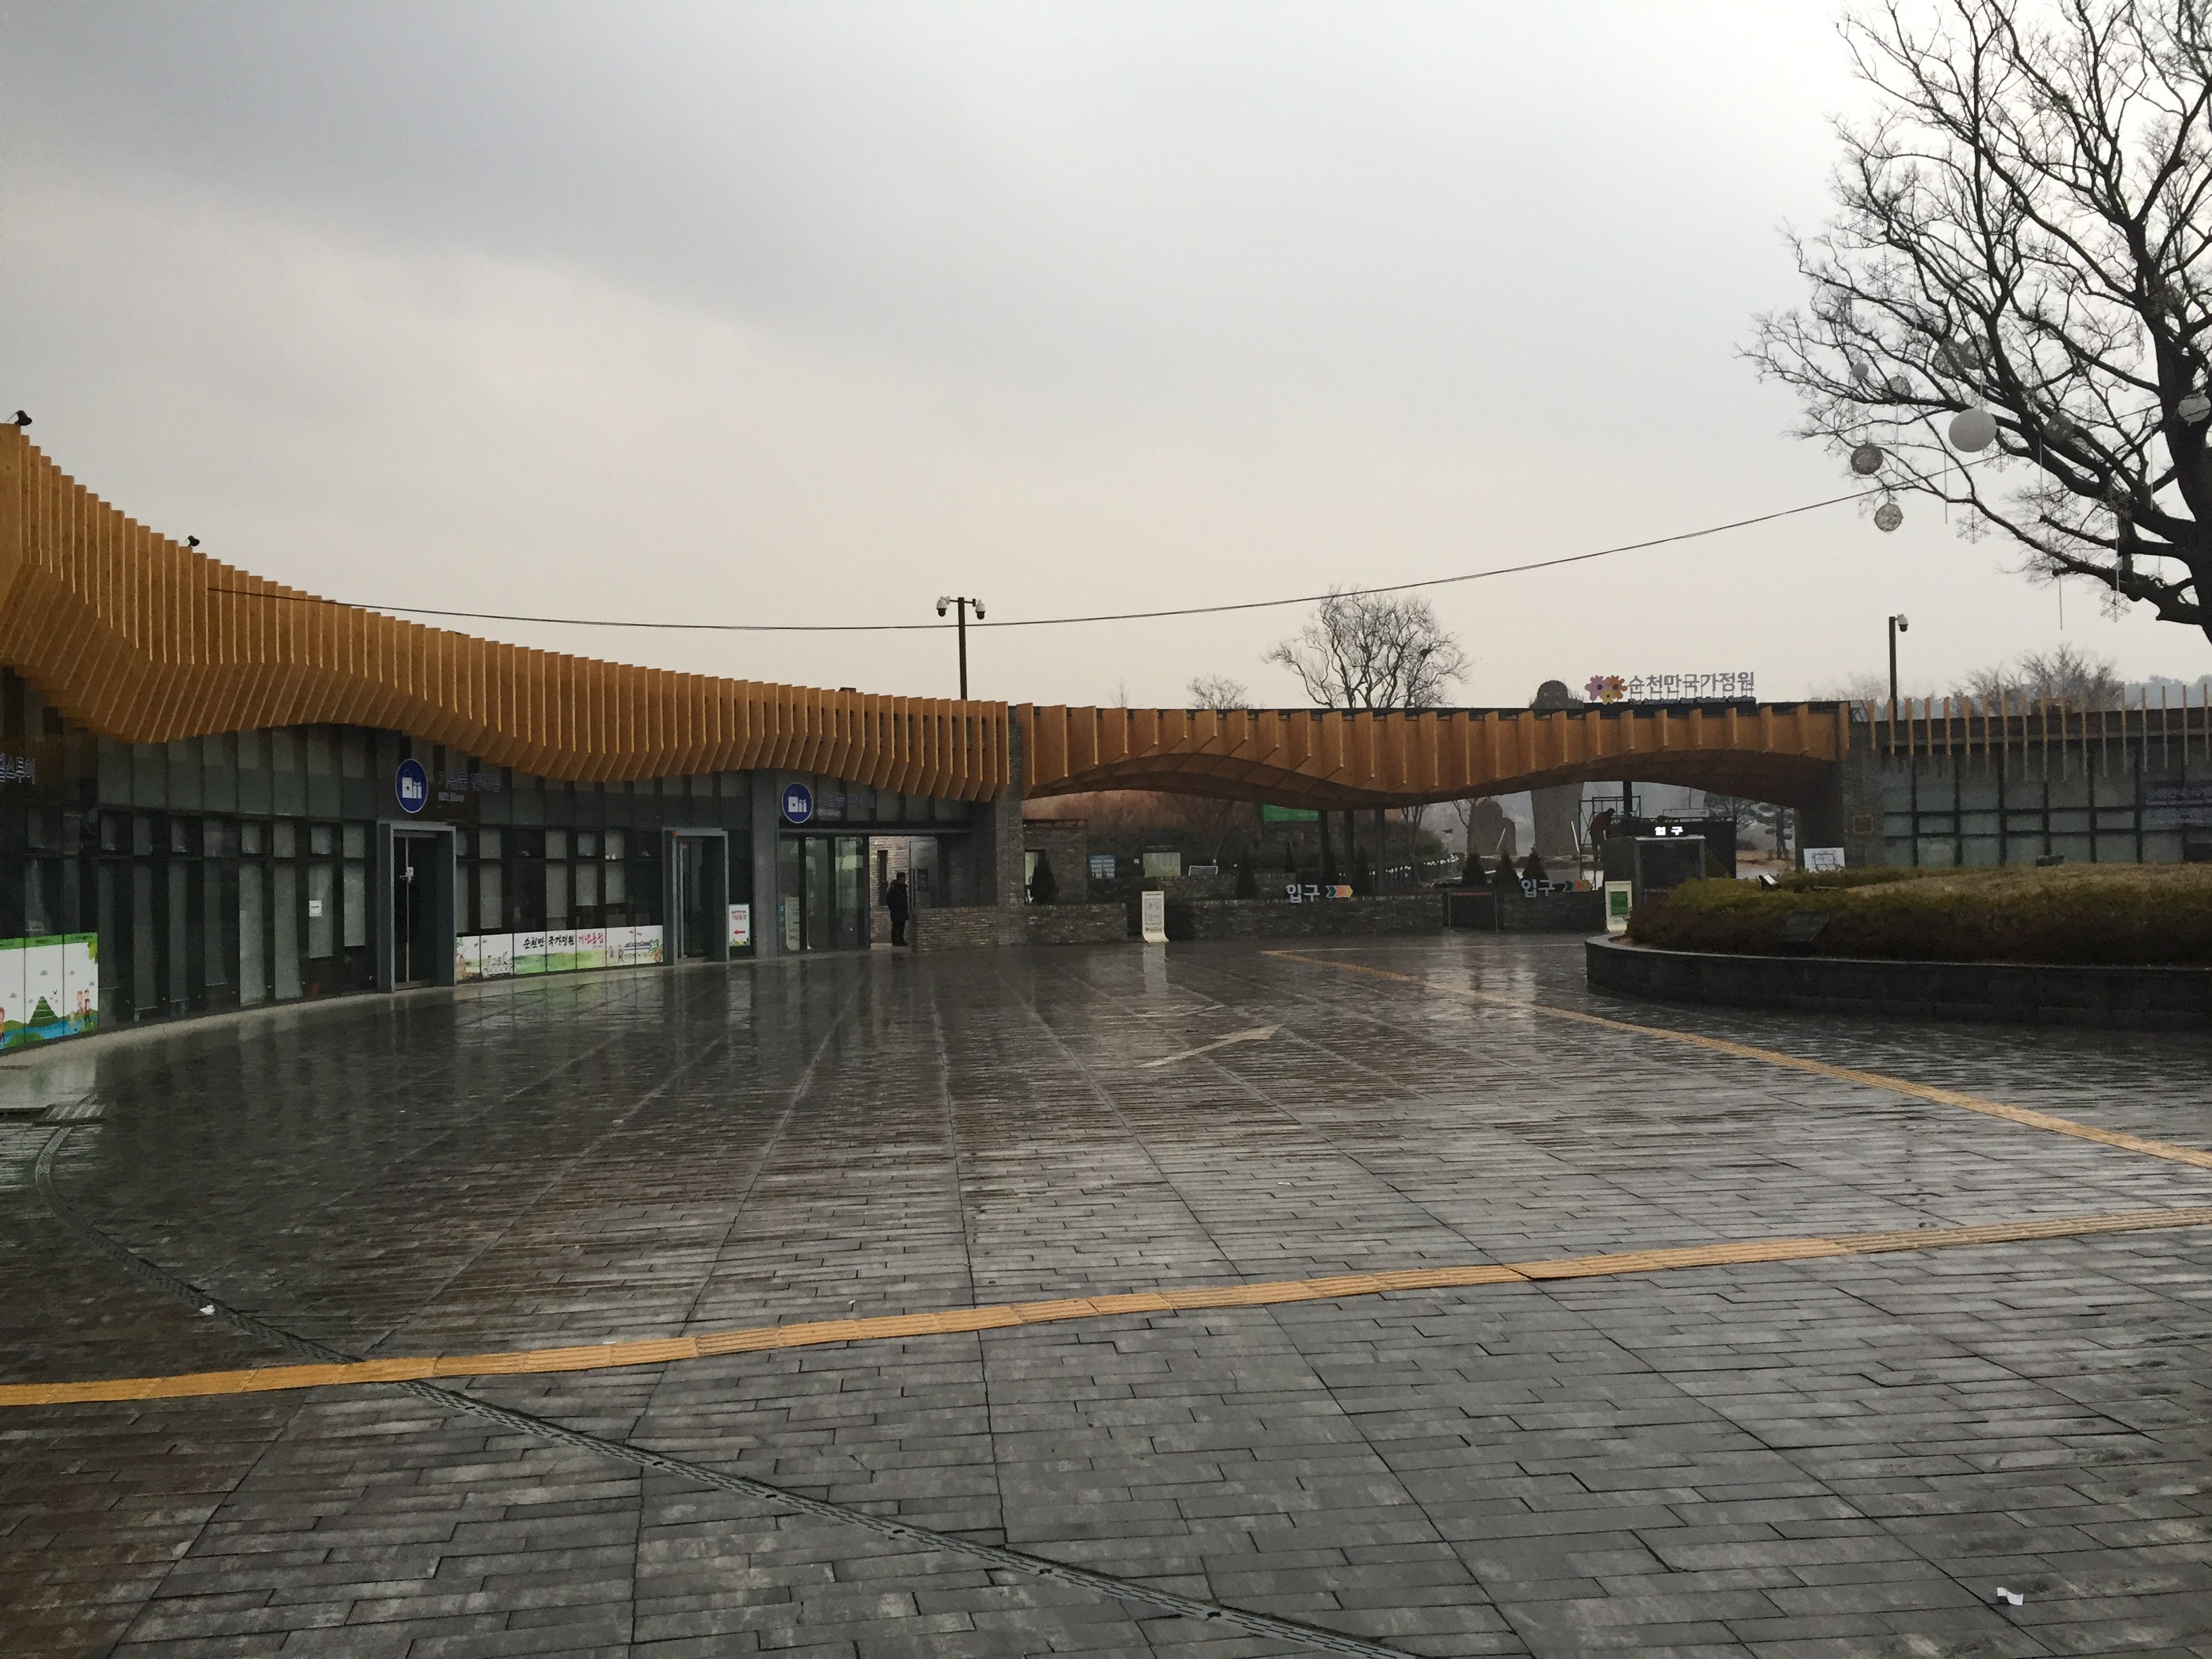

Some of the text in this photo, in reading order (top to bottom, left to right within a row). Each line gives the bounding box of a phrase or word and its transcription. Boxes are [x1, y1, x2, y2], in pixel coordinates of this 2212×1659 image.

[1628, 672, 1754, 693] 순천만국가정원
[1680, 697, 1694, 705] Bay
[1696, 695, 1726, 703] National
[1728, 695, 1756, 703] Garden
[1286, 884, 1320, 903] 입구
[1521, 879, 1555, 897] 입구
[523, 936, 545, 949] 순천만
[548, 935, 575, 947] 국가정원
